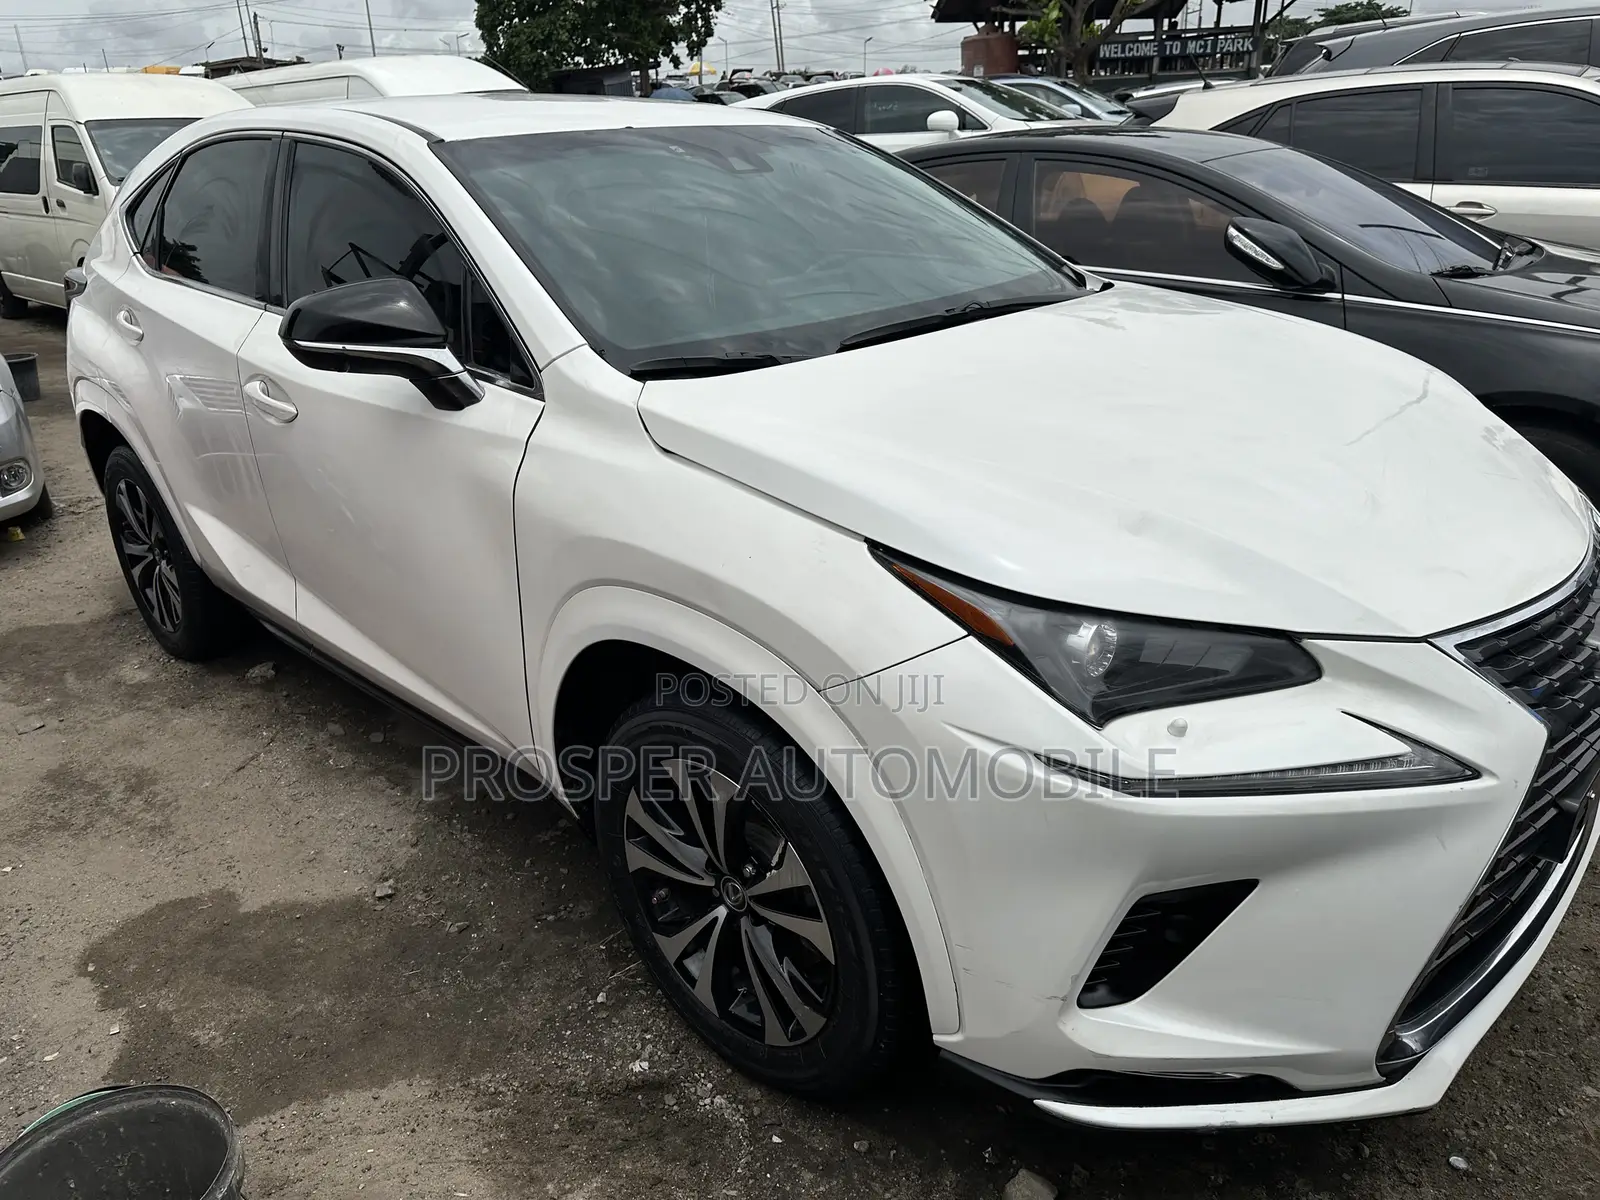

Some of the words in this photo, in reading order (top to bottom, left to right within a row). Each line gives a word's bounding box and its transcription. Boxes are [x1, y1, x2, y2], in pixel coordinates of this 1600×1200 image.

[1100, 42, 1158, 58] WELCOME
[1165, 40, 1181, 54] TO
[1217, 37, 1253, 51] PARK
